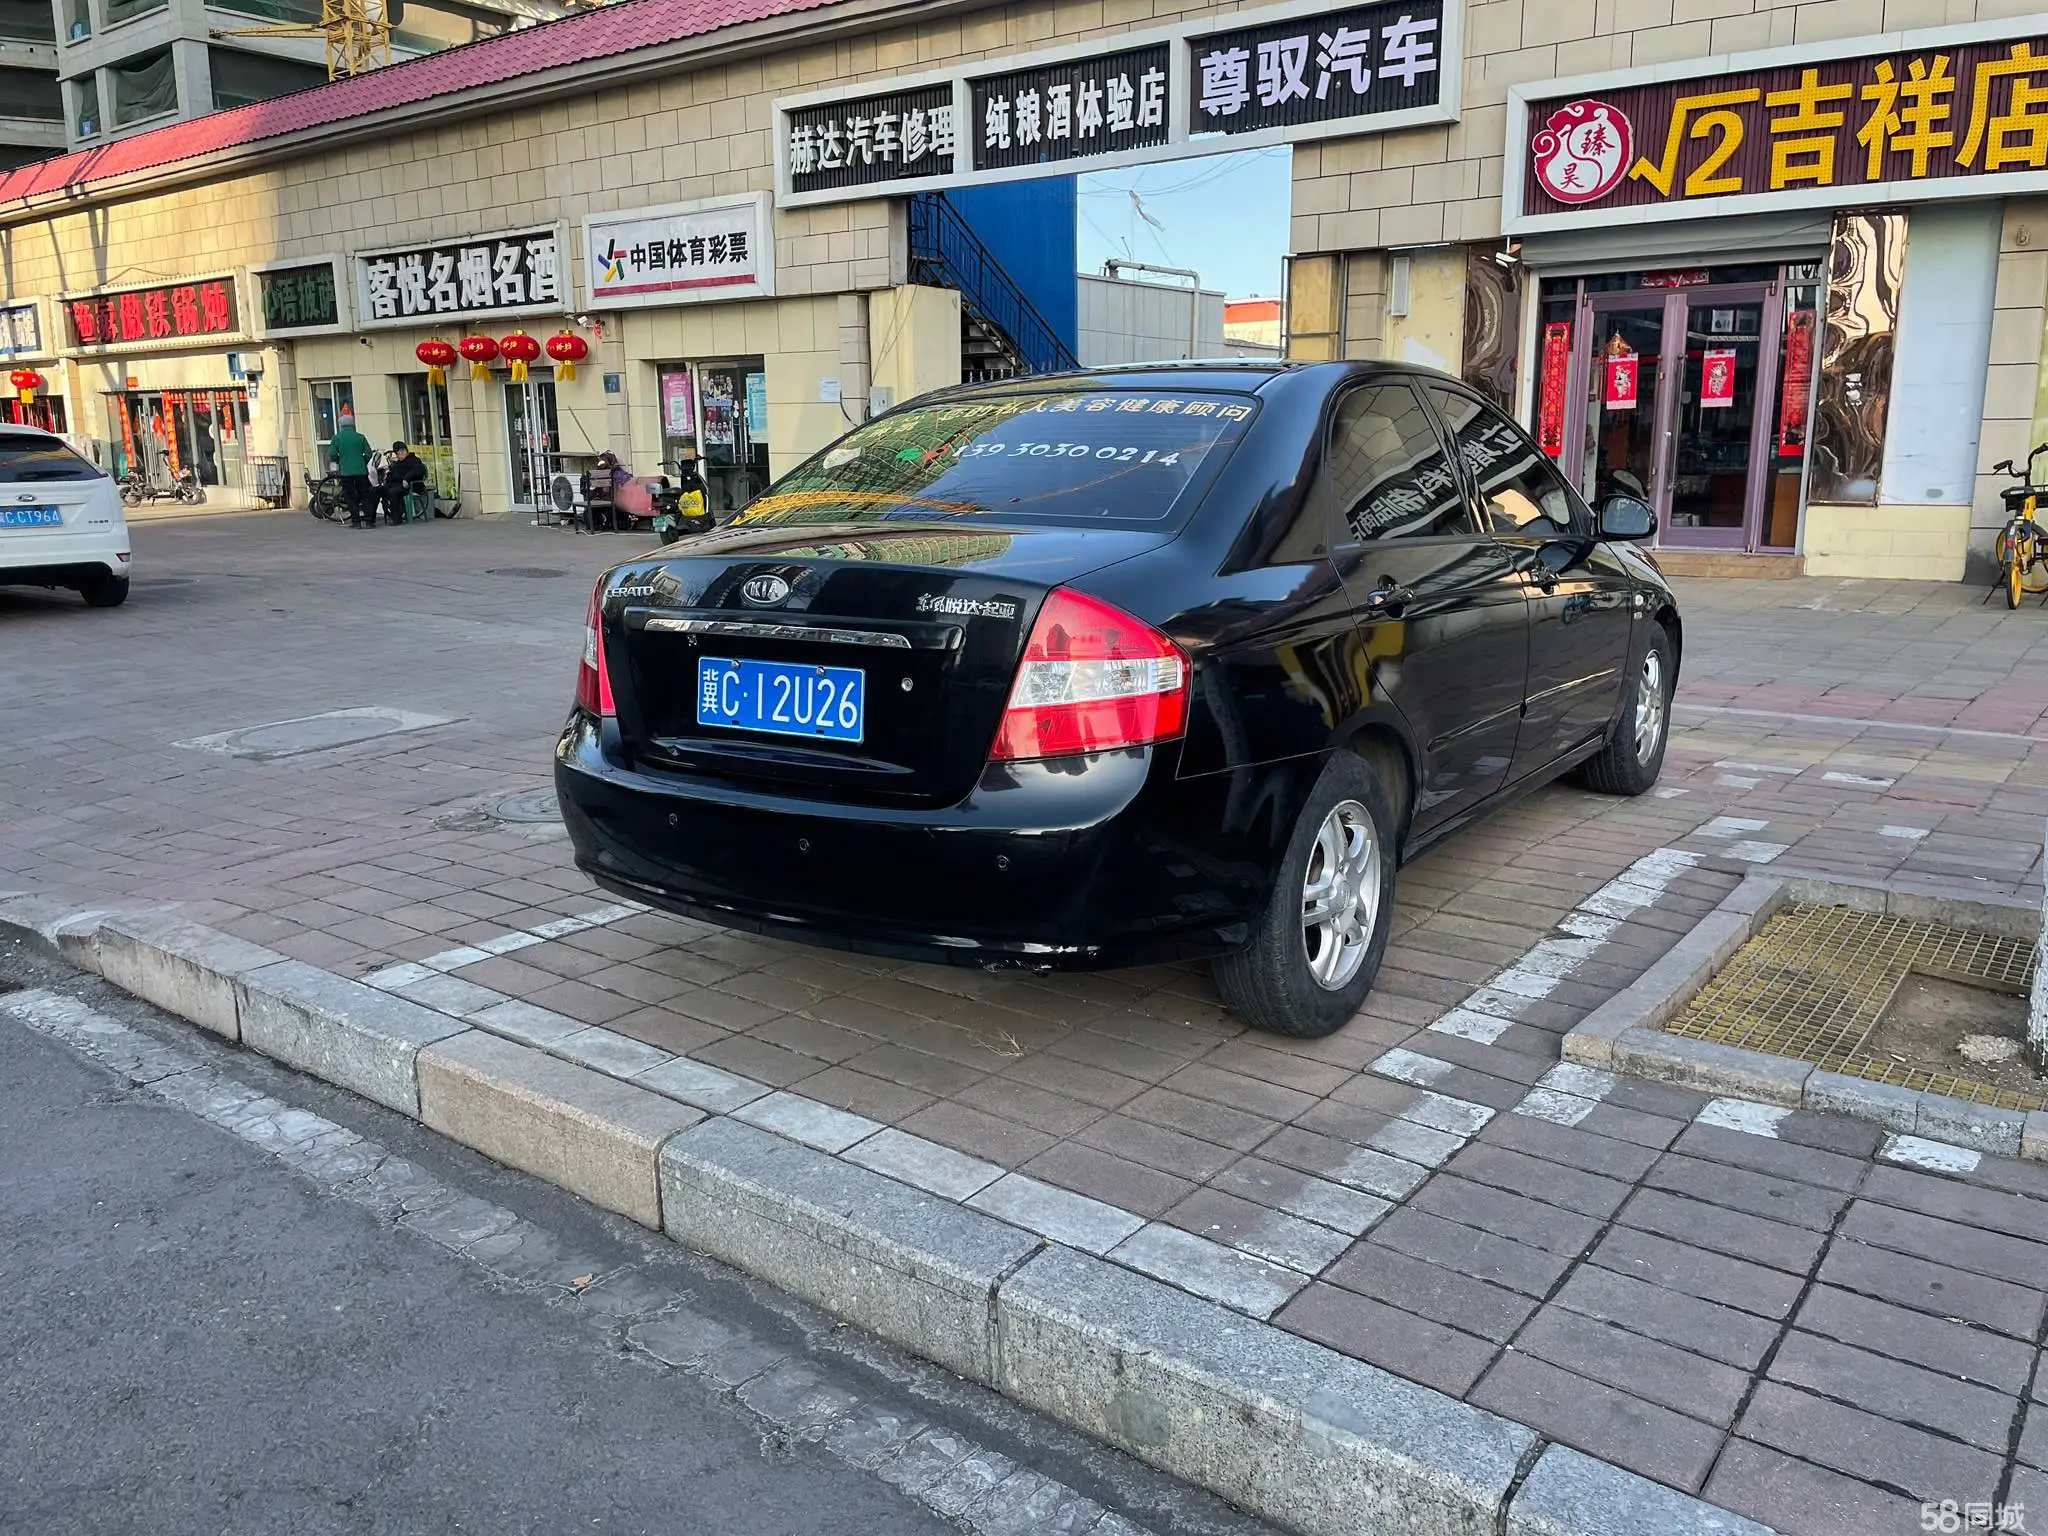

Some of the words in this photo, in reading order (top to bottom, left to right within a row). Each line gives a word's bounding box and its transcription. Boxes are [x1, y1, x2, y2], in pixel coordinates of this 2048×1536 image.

[1200, 15, 1437, 116] 尊驭汽车
[986, 66, 1165, 149] 纯粮酒体验店
[790, 105, 954, 175] 赫达汽车修理
[367, 238, 556, 318] 客悦名烟名酒
[631, 231, 748, 272] 中国体育彩票
[952, 443, 1006, 458] 139
[1008, 442, 1090, 458] 3030
[1095, 447, 1179, 466] 0214
[605, 585, 654, 598] CERATO
[749, 580, 784, 600] KIA
